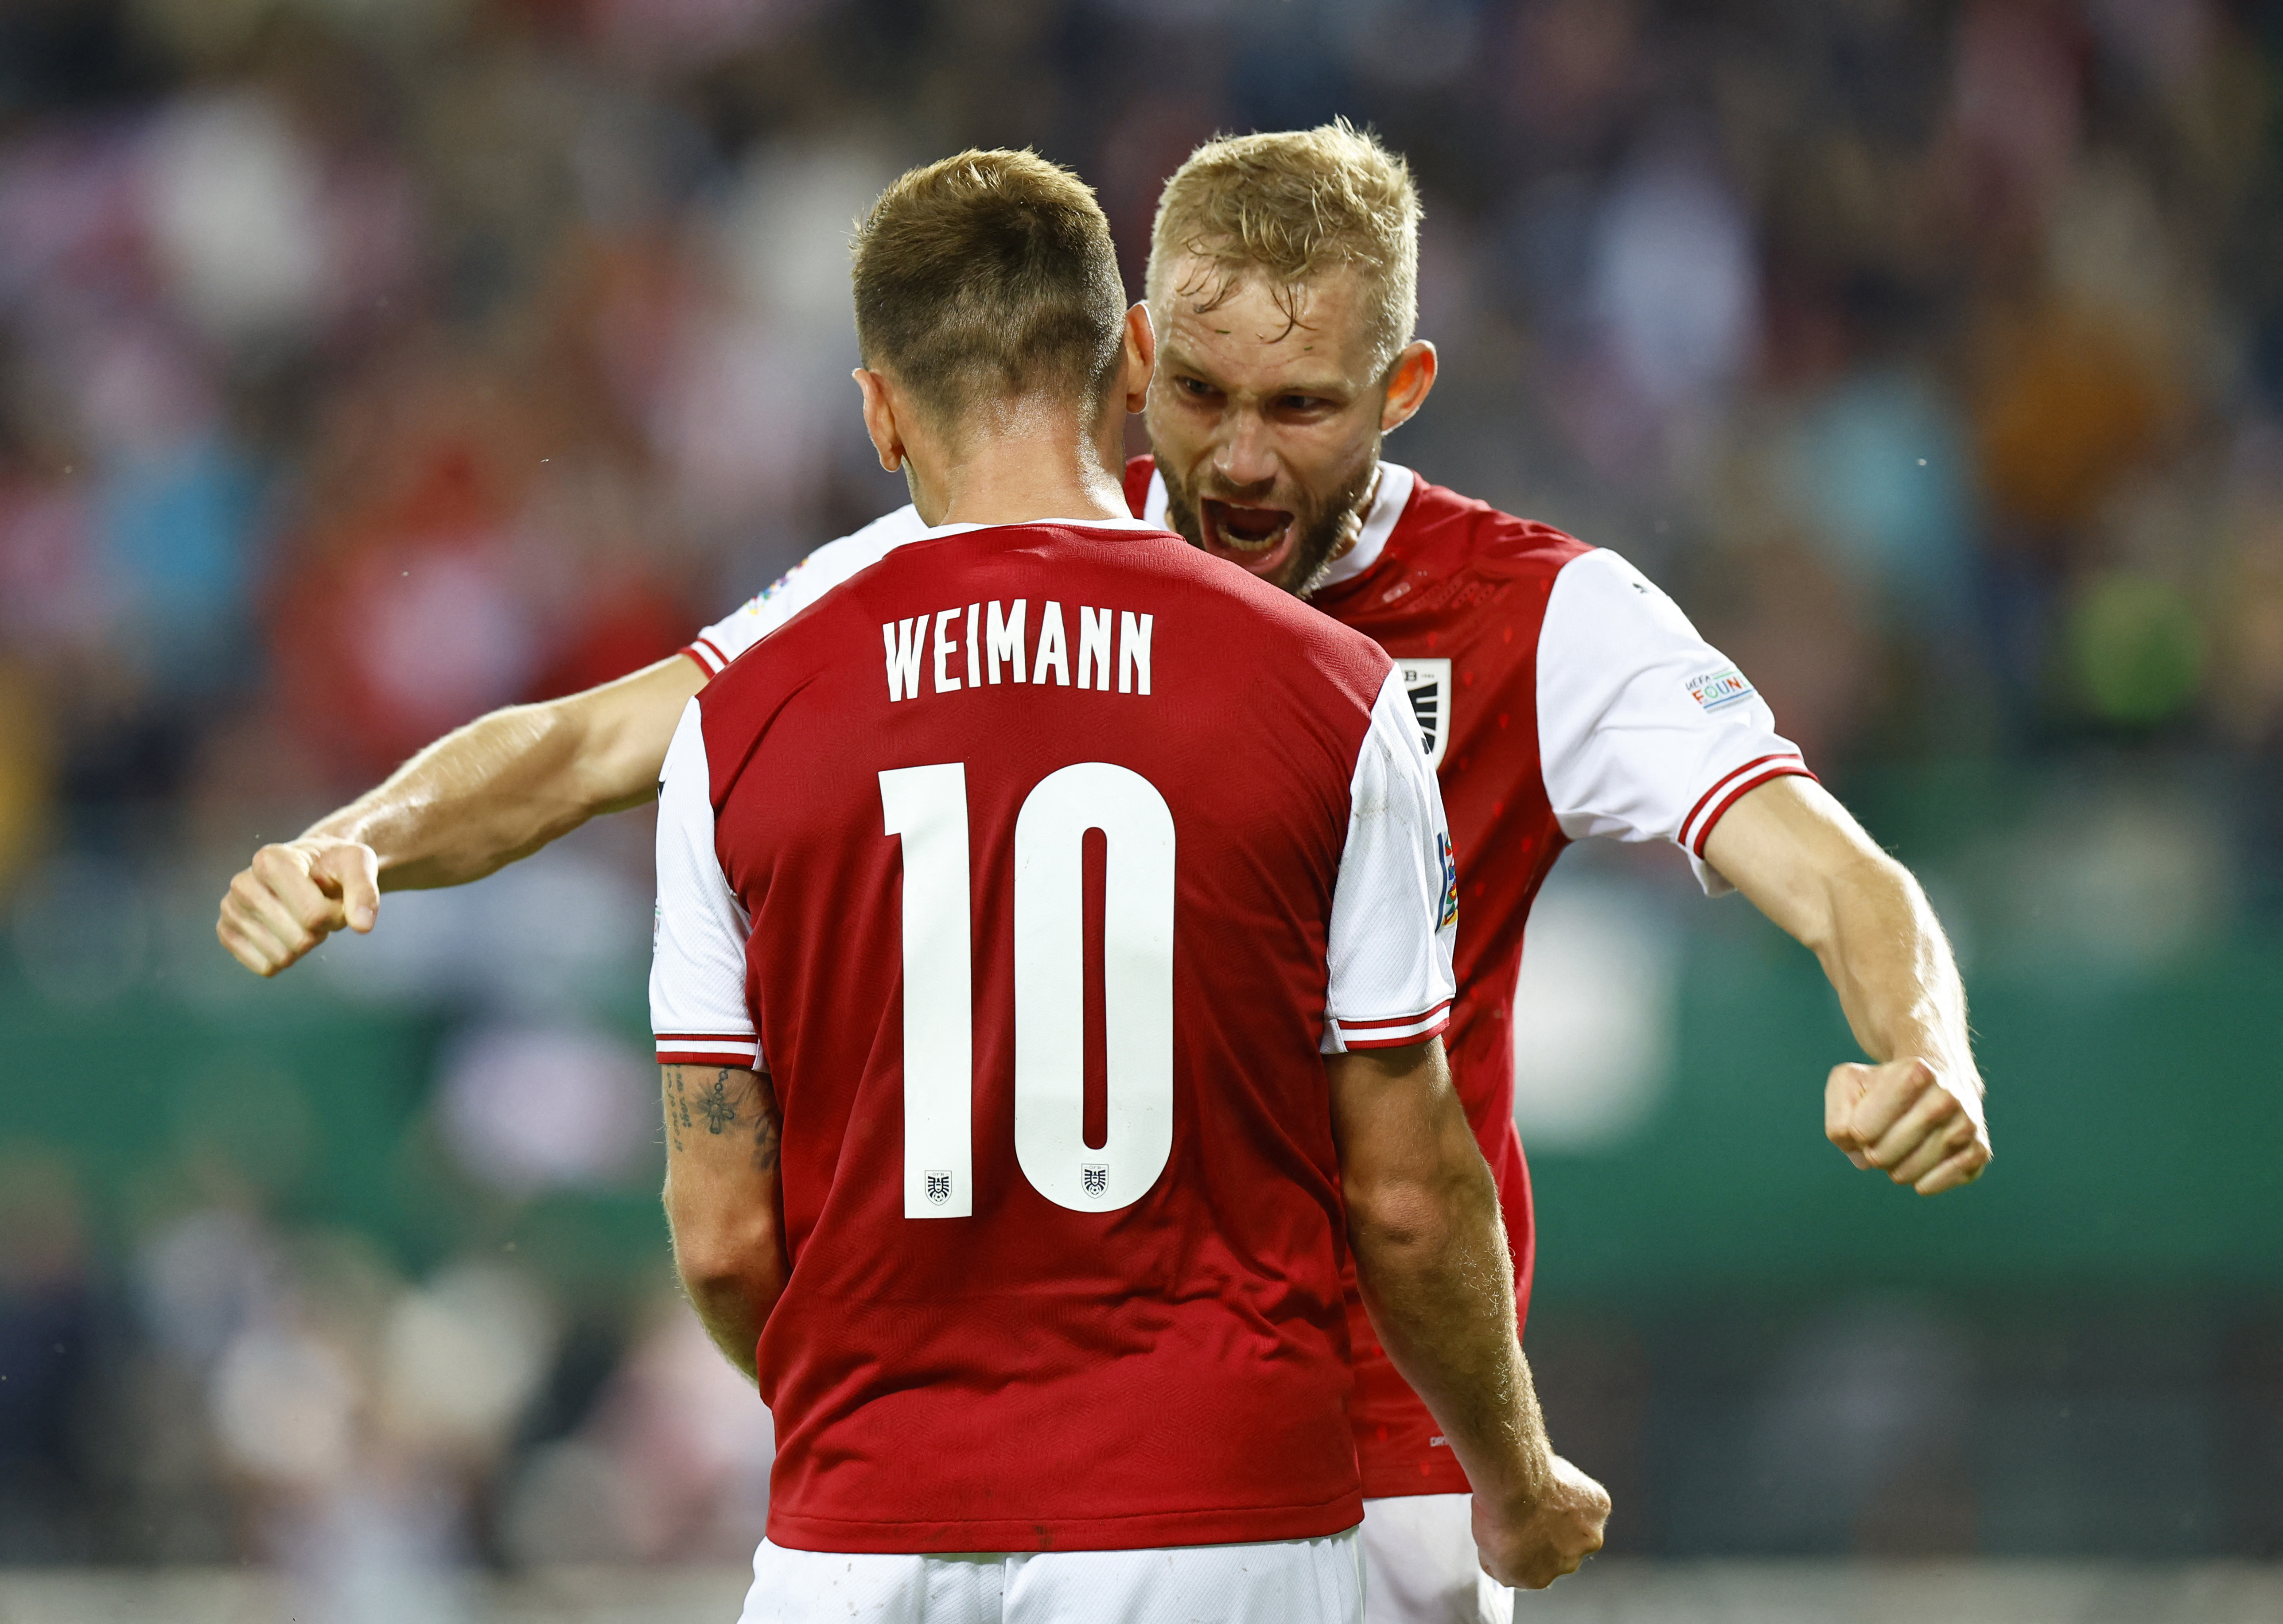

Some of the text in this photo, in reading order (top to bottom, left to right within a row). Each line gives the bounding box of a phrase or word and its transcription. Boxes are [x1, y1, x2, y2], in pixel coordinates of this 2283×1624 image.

[882, 598, 1154, 703] WEIMANN
[1685, 674, 1711, 691] UEFA
[877, 761, 1176, 1219] 10
